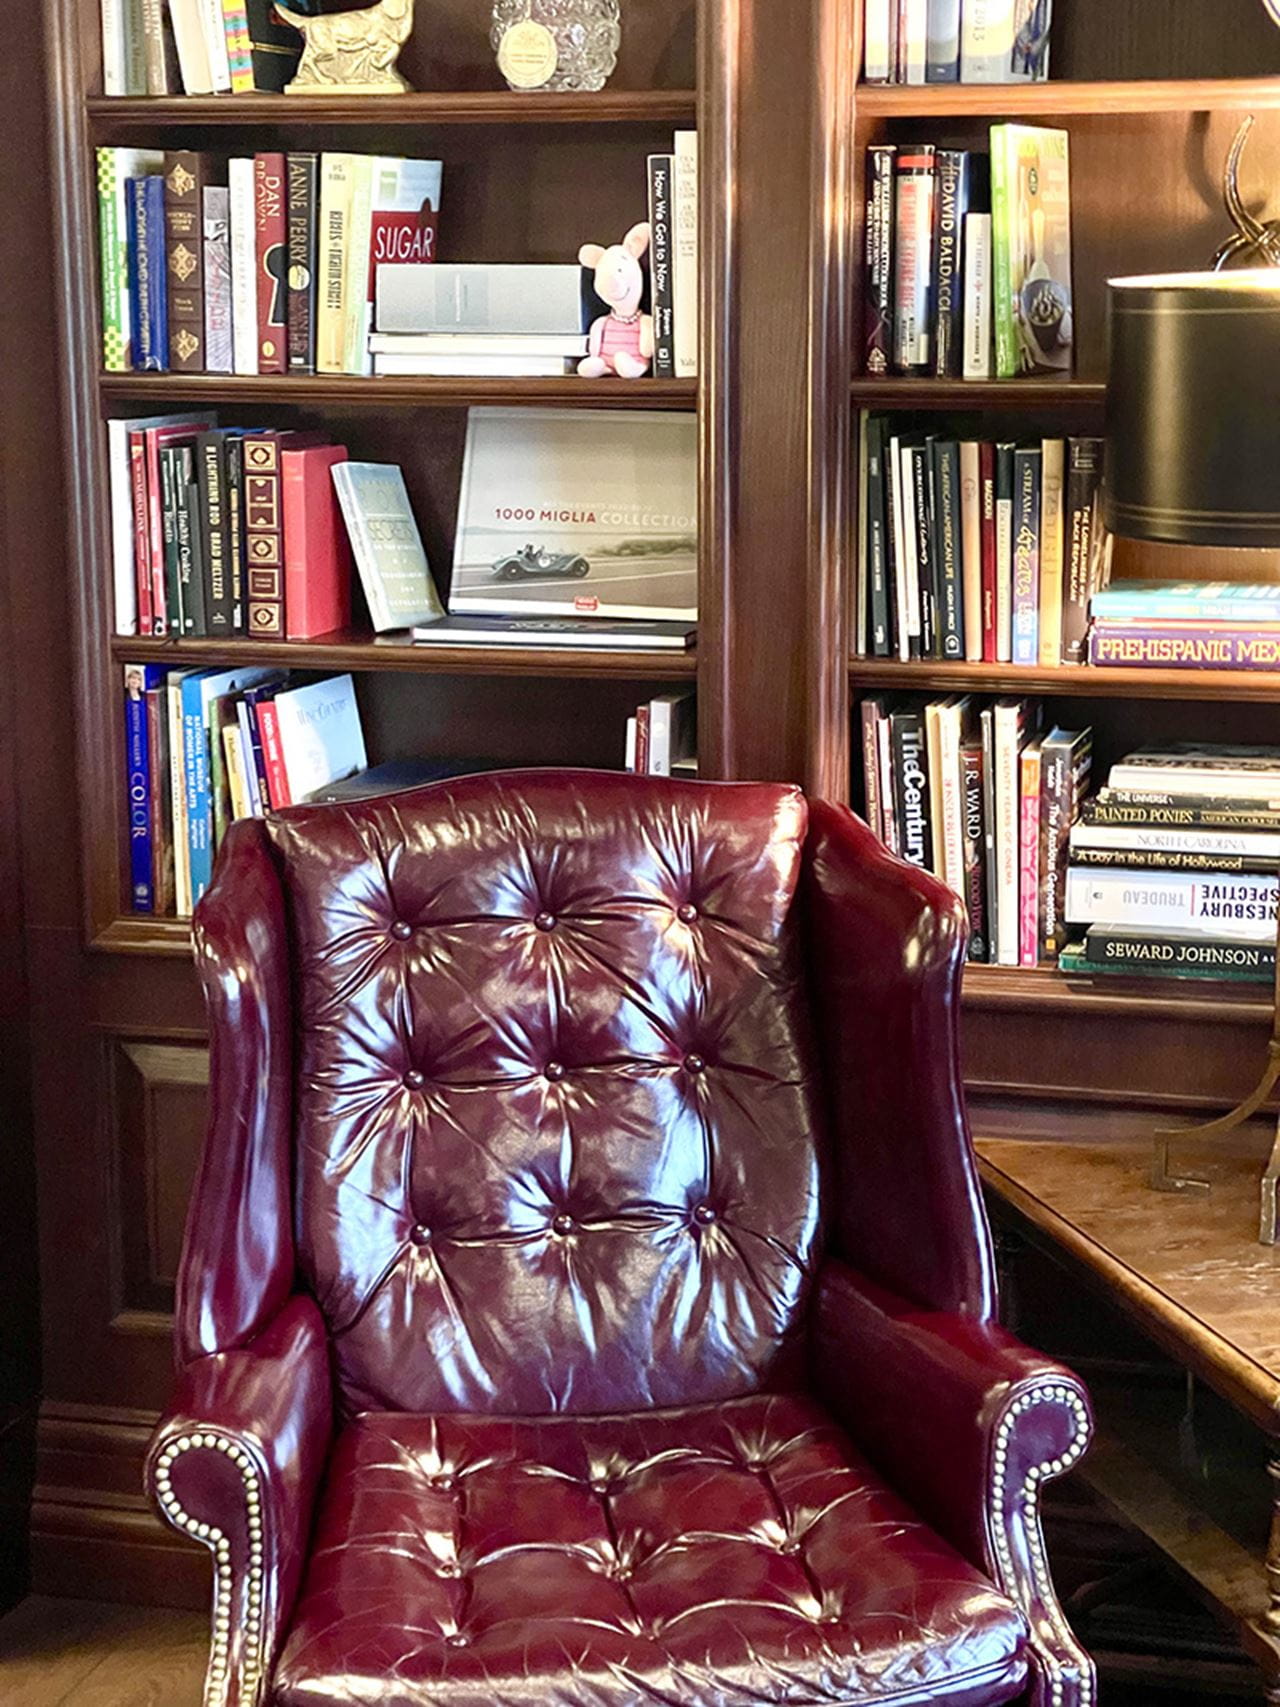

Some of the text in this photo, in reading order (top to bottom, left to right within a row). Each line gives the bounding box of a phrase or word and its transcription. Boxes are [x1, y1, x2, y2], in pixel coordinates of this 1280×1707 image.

[266, 176, 280, 217] DAN
[290, 164, 308, 262] ANNE PERRY
[374, 225, 434, 260] SUGAR
[653, 170, 668, 292] How We Got to Now
[939, 182, 955, 311] DAVID BALDACCI
[138, 252, 149, 281] LOVED
[941, 453, 950, 472] THIS
[1022, 469, 1033, 512] STREAM
[163, 510, 174, 543] Risotto
[178, 510, 189, 547] Healthy
[206, 455, 223, 599] LIGHTNING ROD BRAD MELTZER
[495, 508, 697, 527] 1000 MIGLIA COLLECTION
[1082, 505, 1091, 524] THE
[180, 548, 191, 584] Cooking
[1070, 511, 1081, 602] BLACK REPUBLICAN
[1079, 526, 1090, 583] LONELINESS
[944, 563, 954, 580] LIFE
[1097, 637, 1232, 662] PREHISPANIC
[185, 715, 193, 725] OF
[185, 727, 195, 759] WOMEN
[193, 716, 205, 793] NATIONAL MUSEUM
[965, 756, 979, 767] J.
[966, 770, 979, 785] R.
[1046, 765, 1055, 789] Haidt
[1054, 757, 1064, 797] Jonathan
[188, 772, 196, 786] THE
[130, 772, 147, 838] COLOR
[188, 787, 197, 808] ARTS
[966, 788, 981, 839] WARD
[1116, 793, 1168, 804] THE UNIVERSE
[1003, 747, 1012, 885] SEVENTY YEARS OF CINEMA
[1094, 807, 1147, 822] PAINTED
[1149, 808, 1194, 823] PONIES
[1137, 833, 1247, 850] NORTH CAROLINA
[1045, 803, 1061, 936] The Anxious Generation
[1076, 850, 1243, 870] A Day in the Life of Hollywood
[1123, 890, 1184, 907] TRUDEAU
[1106, 941, 1259, 966] SEWARD JOHNSON
